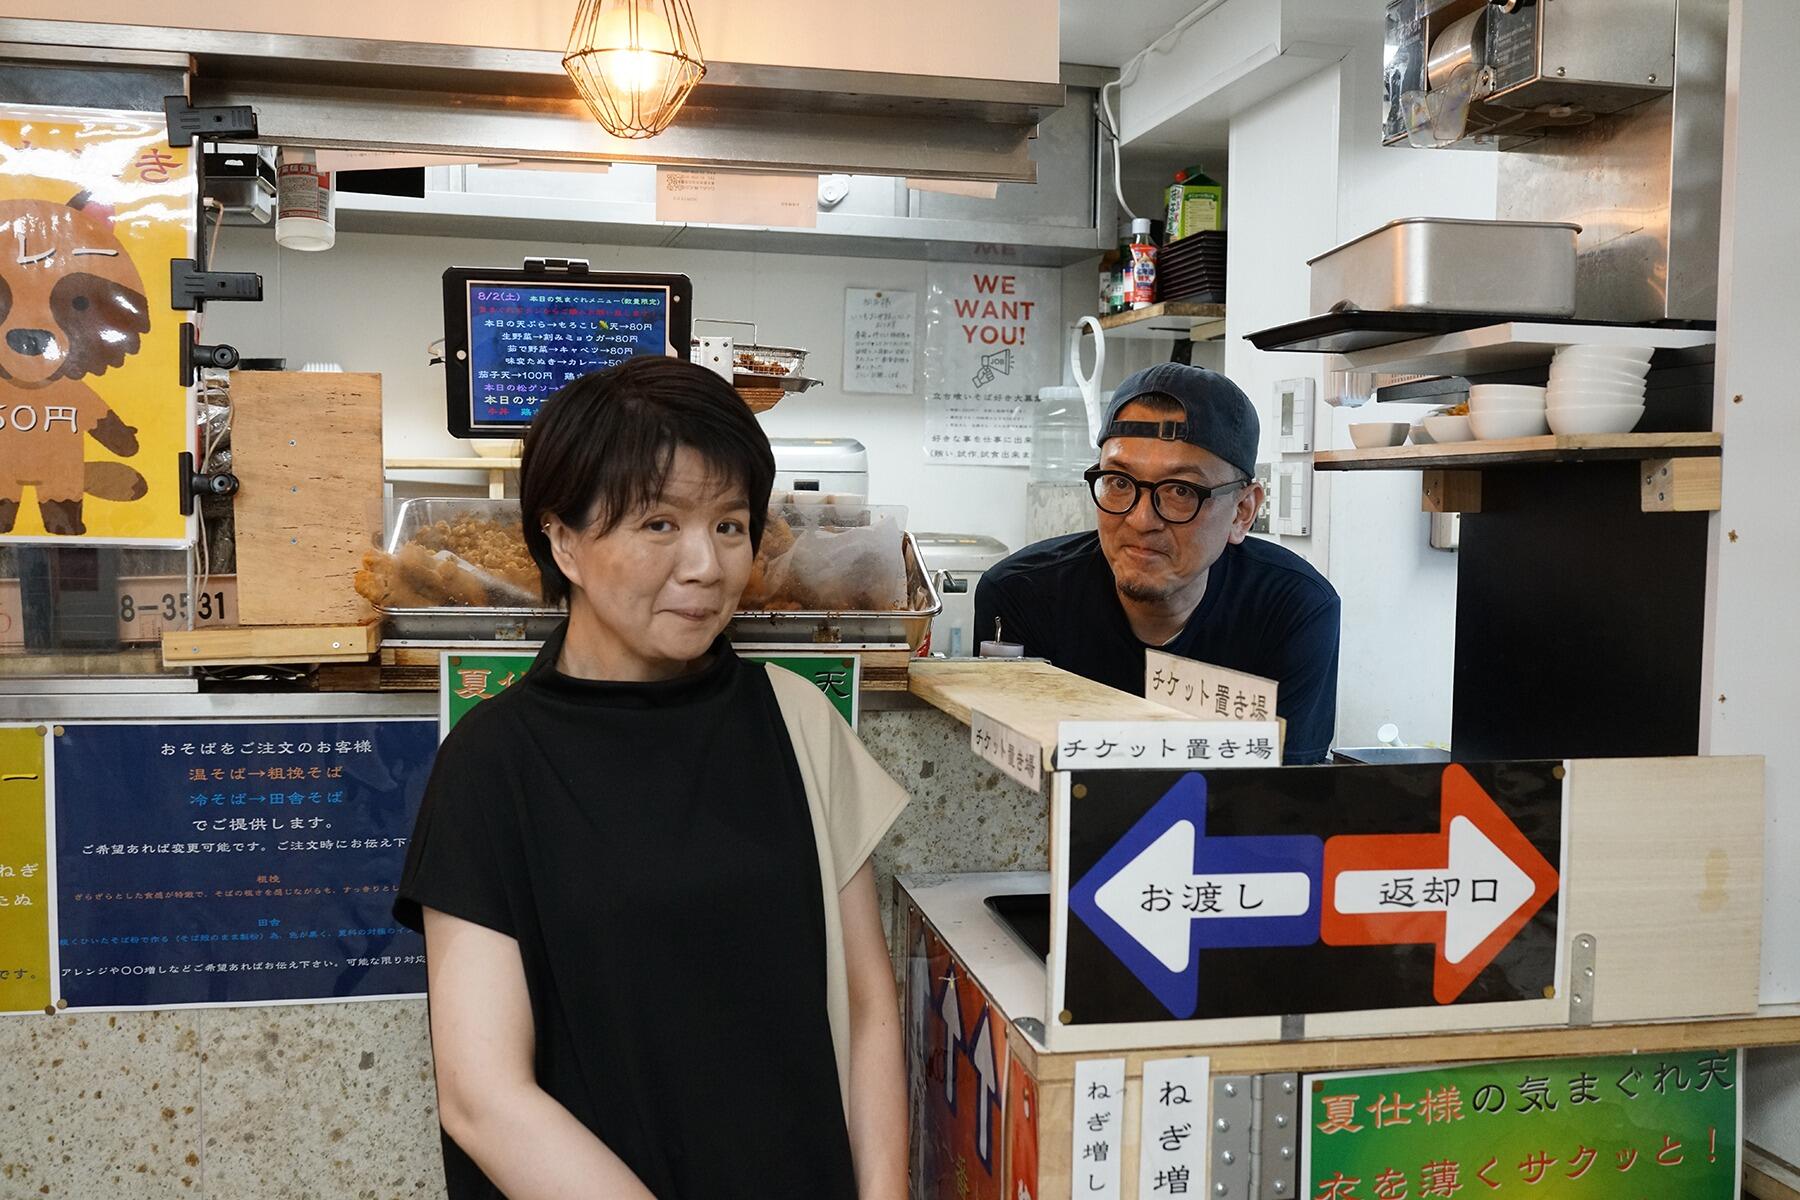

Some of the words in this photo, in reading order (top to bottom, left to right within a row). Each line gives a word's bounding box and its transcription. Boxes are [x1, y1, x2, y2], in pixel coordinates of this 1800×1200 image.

[973, 274, 1016, 295] WE
[478, 291, 520, 302] 8/2(土)
[954, 299, 1035, 320] WANT
[962, 325, 1025, 345] YOU!
[991, 357, 1005, 366] JOB
[160, 740, 372, 756] おそばをご注文のお客様
[1063, 737, 1275, 761] チケット置き場
[192, 816, 334, 832] でご提供します。
[1140, 882, 1264, 913] お渡し
[1379, 877, 1499, 908] 返却口
[1082, 1081, 1112, 1192] ねぎ増し
[1153, 1080, 1193, 1195] ねぎ増
